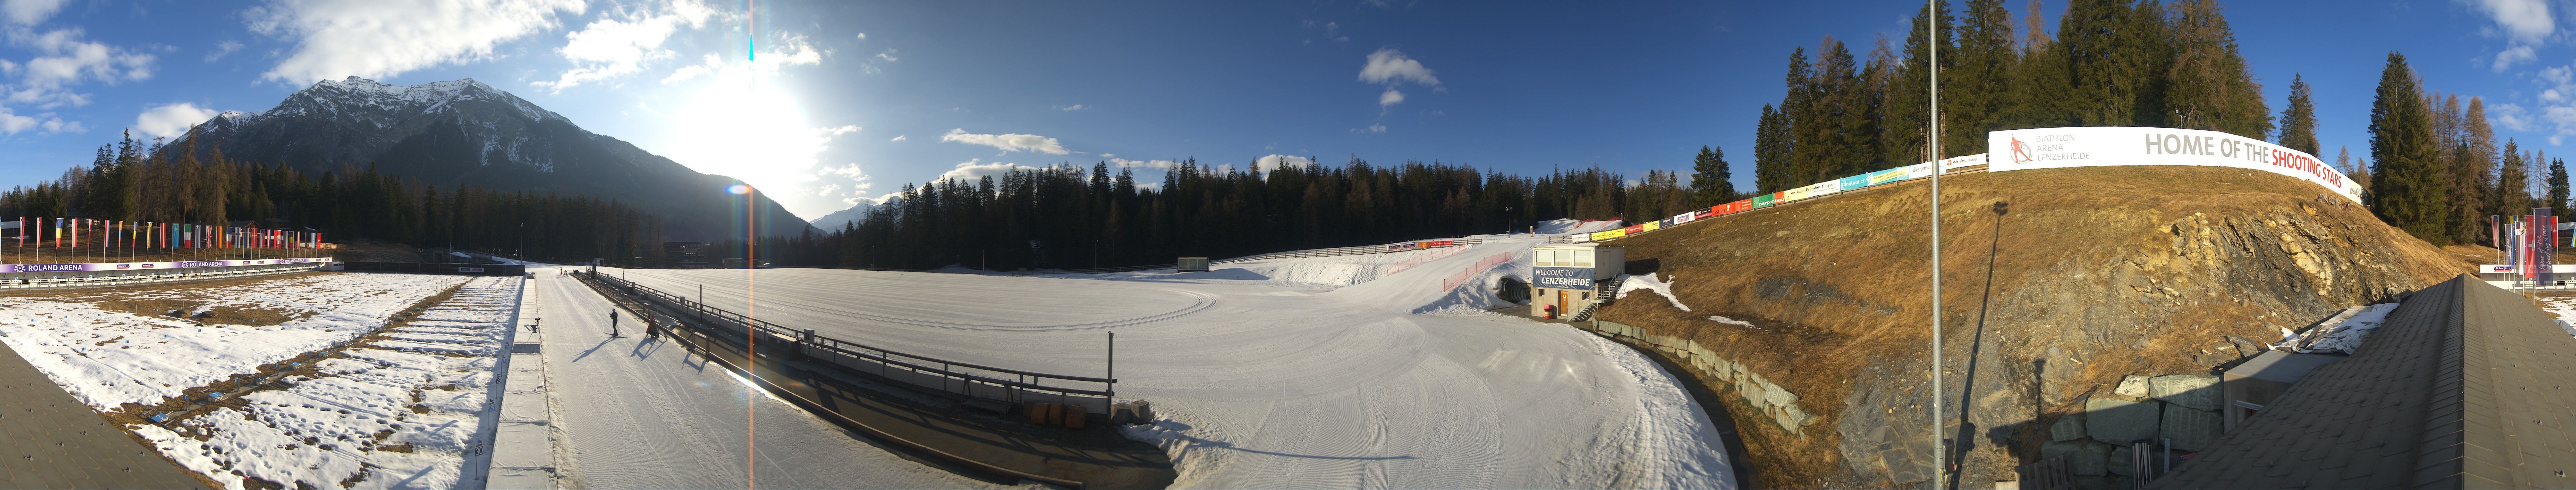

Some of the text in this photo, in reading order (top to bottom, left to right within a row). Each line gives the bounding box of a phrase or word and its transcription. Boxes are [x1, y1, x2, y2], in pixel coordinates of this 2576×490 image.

[2038, 153, 2089, 161] LENZERHEIDE
[2146, 134, 2341, 188] HOME OF THE SHOOTING STARS
[1759, 198, 1784, 206] parpanbau
[1541, 277, 1590, 286] LENZERHEIDE
[476, 447, 483, 455] 30
